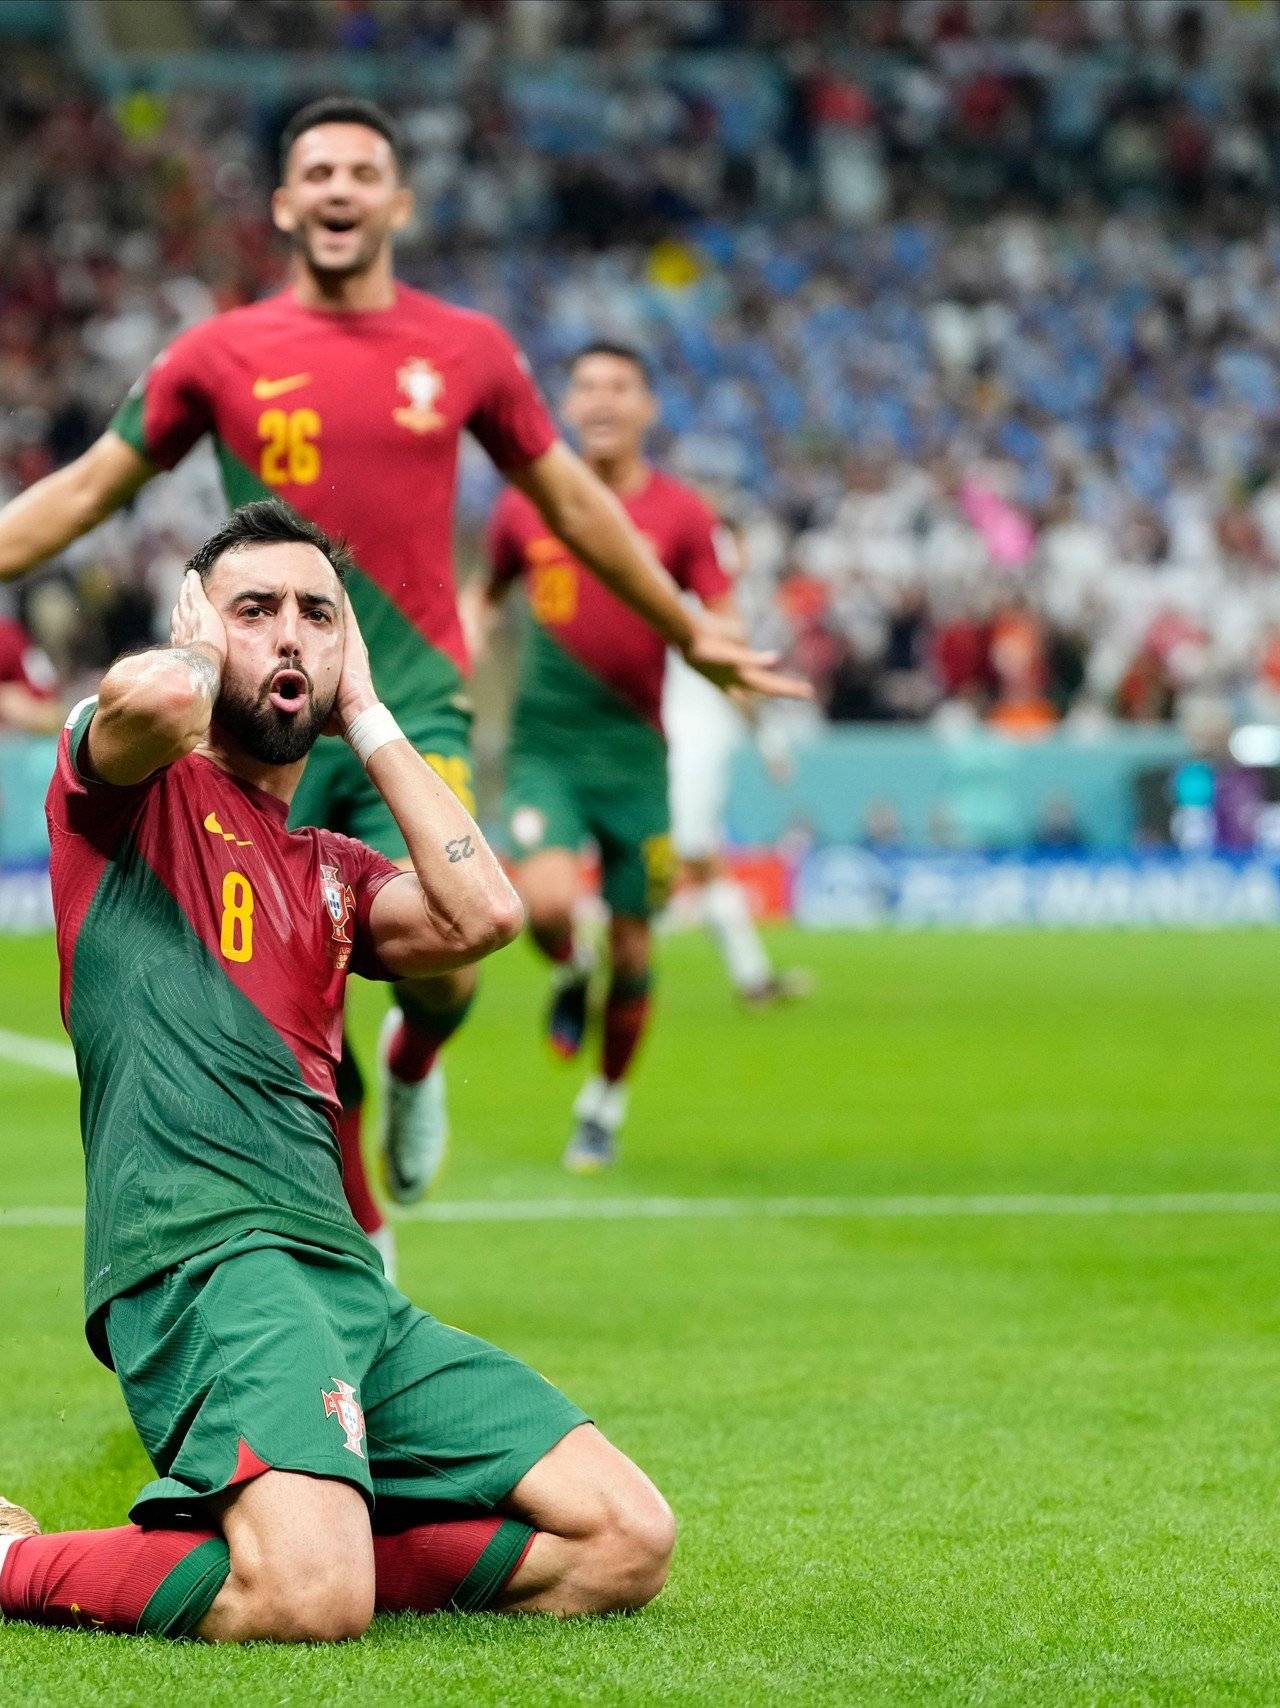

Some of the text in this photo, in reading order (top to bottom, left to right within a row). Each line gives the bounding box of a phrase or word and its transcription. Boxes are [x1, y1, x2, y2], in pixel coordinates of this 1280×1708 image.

[258, 407, 321, 486] 26
[445, 835, 476, 863] 23
[220, 870, 255, 963] 8
